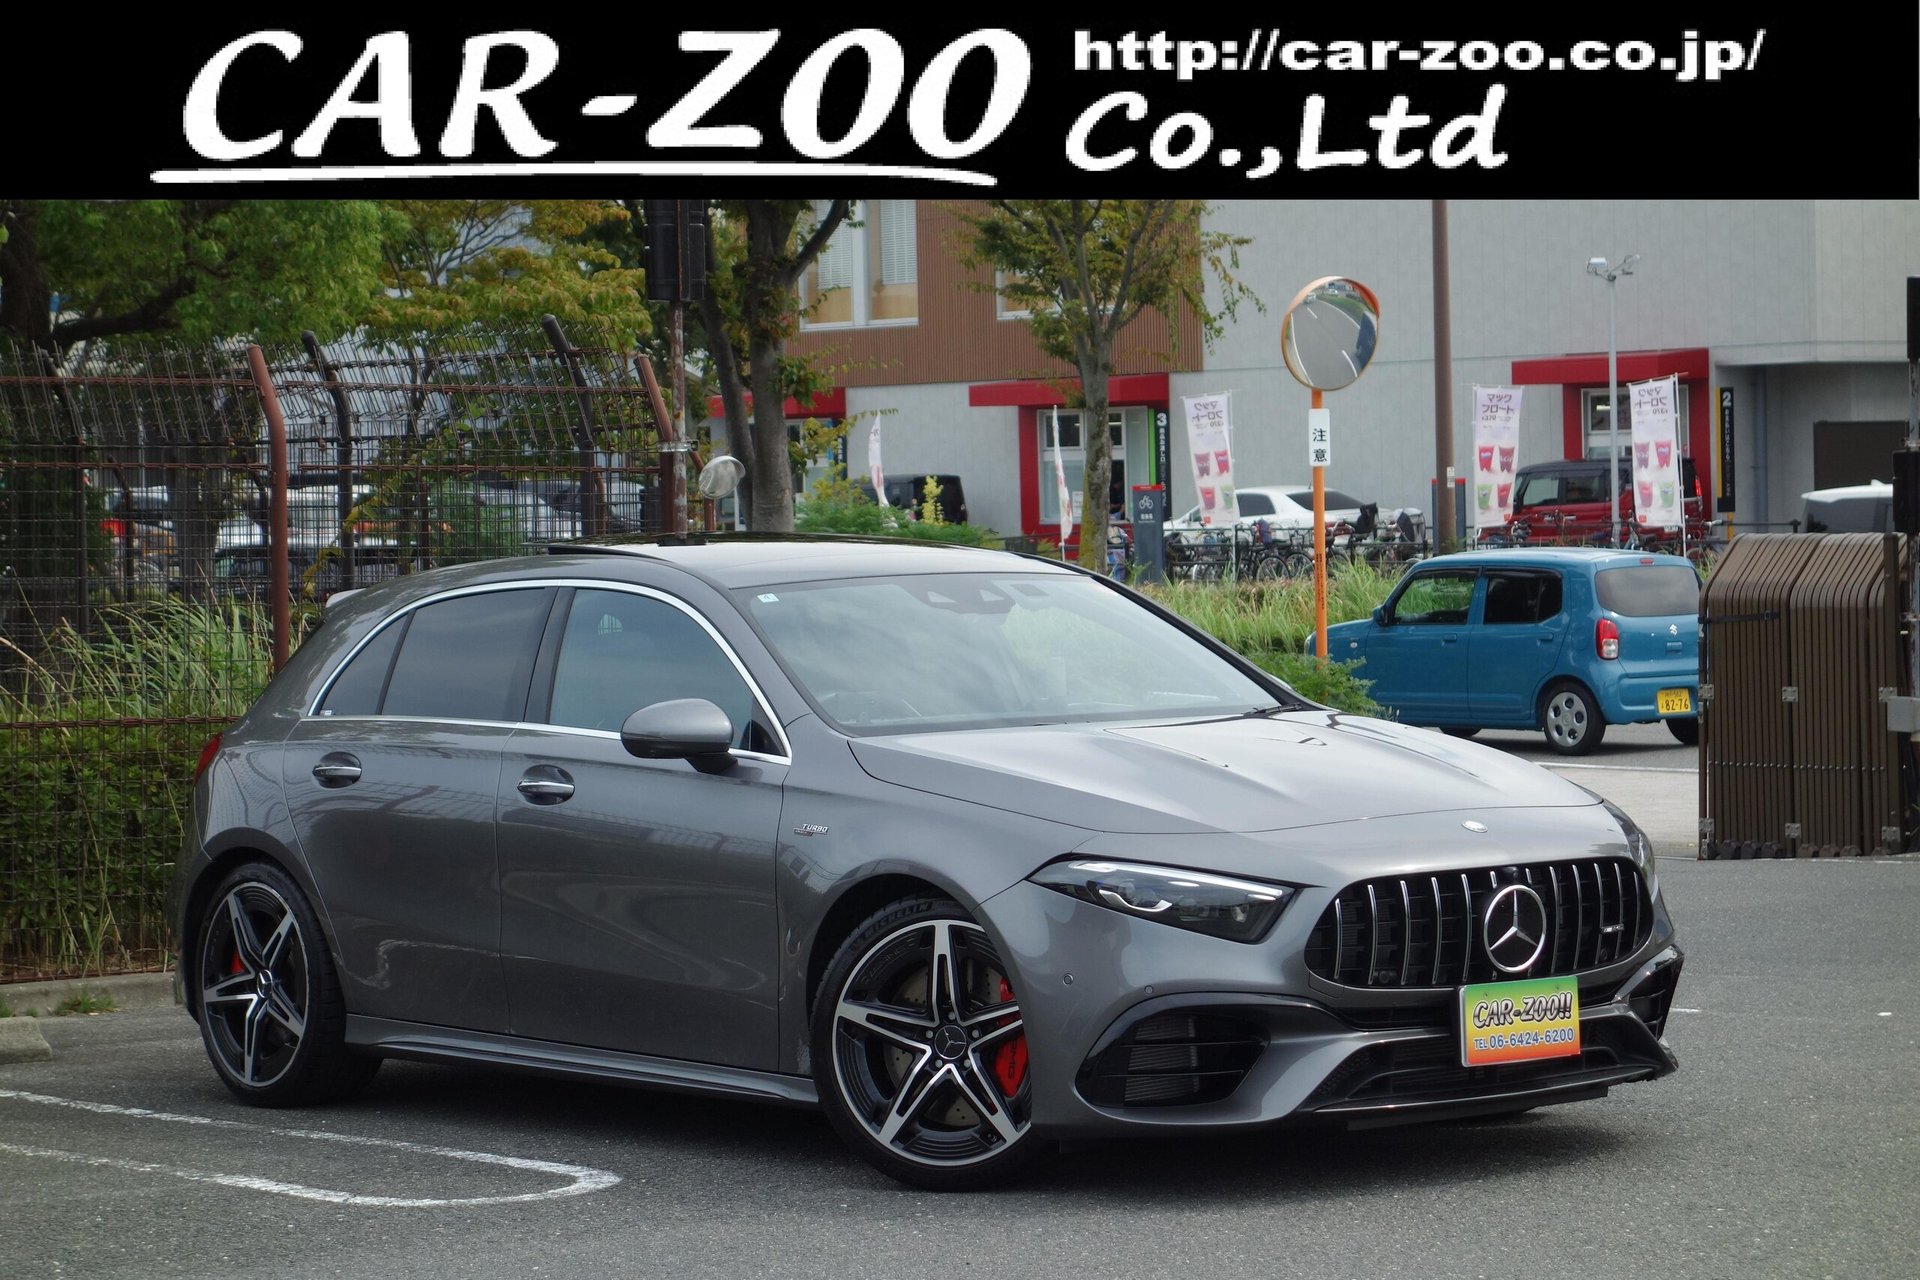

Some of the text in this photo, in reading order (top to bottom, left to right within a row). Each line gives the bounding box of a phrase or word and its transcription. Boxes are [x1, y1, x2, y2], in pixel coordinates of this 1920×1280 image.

[1487, 393, 1512, 404] マック
[1722, 391, 1732, 407] 2
[1156, 412, 1167, 427] 3
[1313, 428, 1327, 462] 注意
[1665, 698, 1689, 711] 82-76
[802, 823, 829, 833] TURBO
[1473, 991, 1573, 1029] CAR-ZOO!!
[1474, 1027, 1574, 1050] TEL 06-6424-6200
